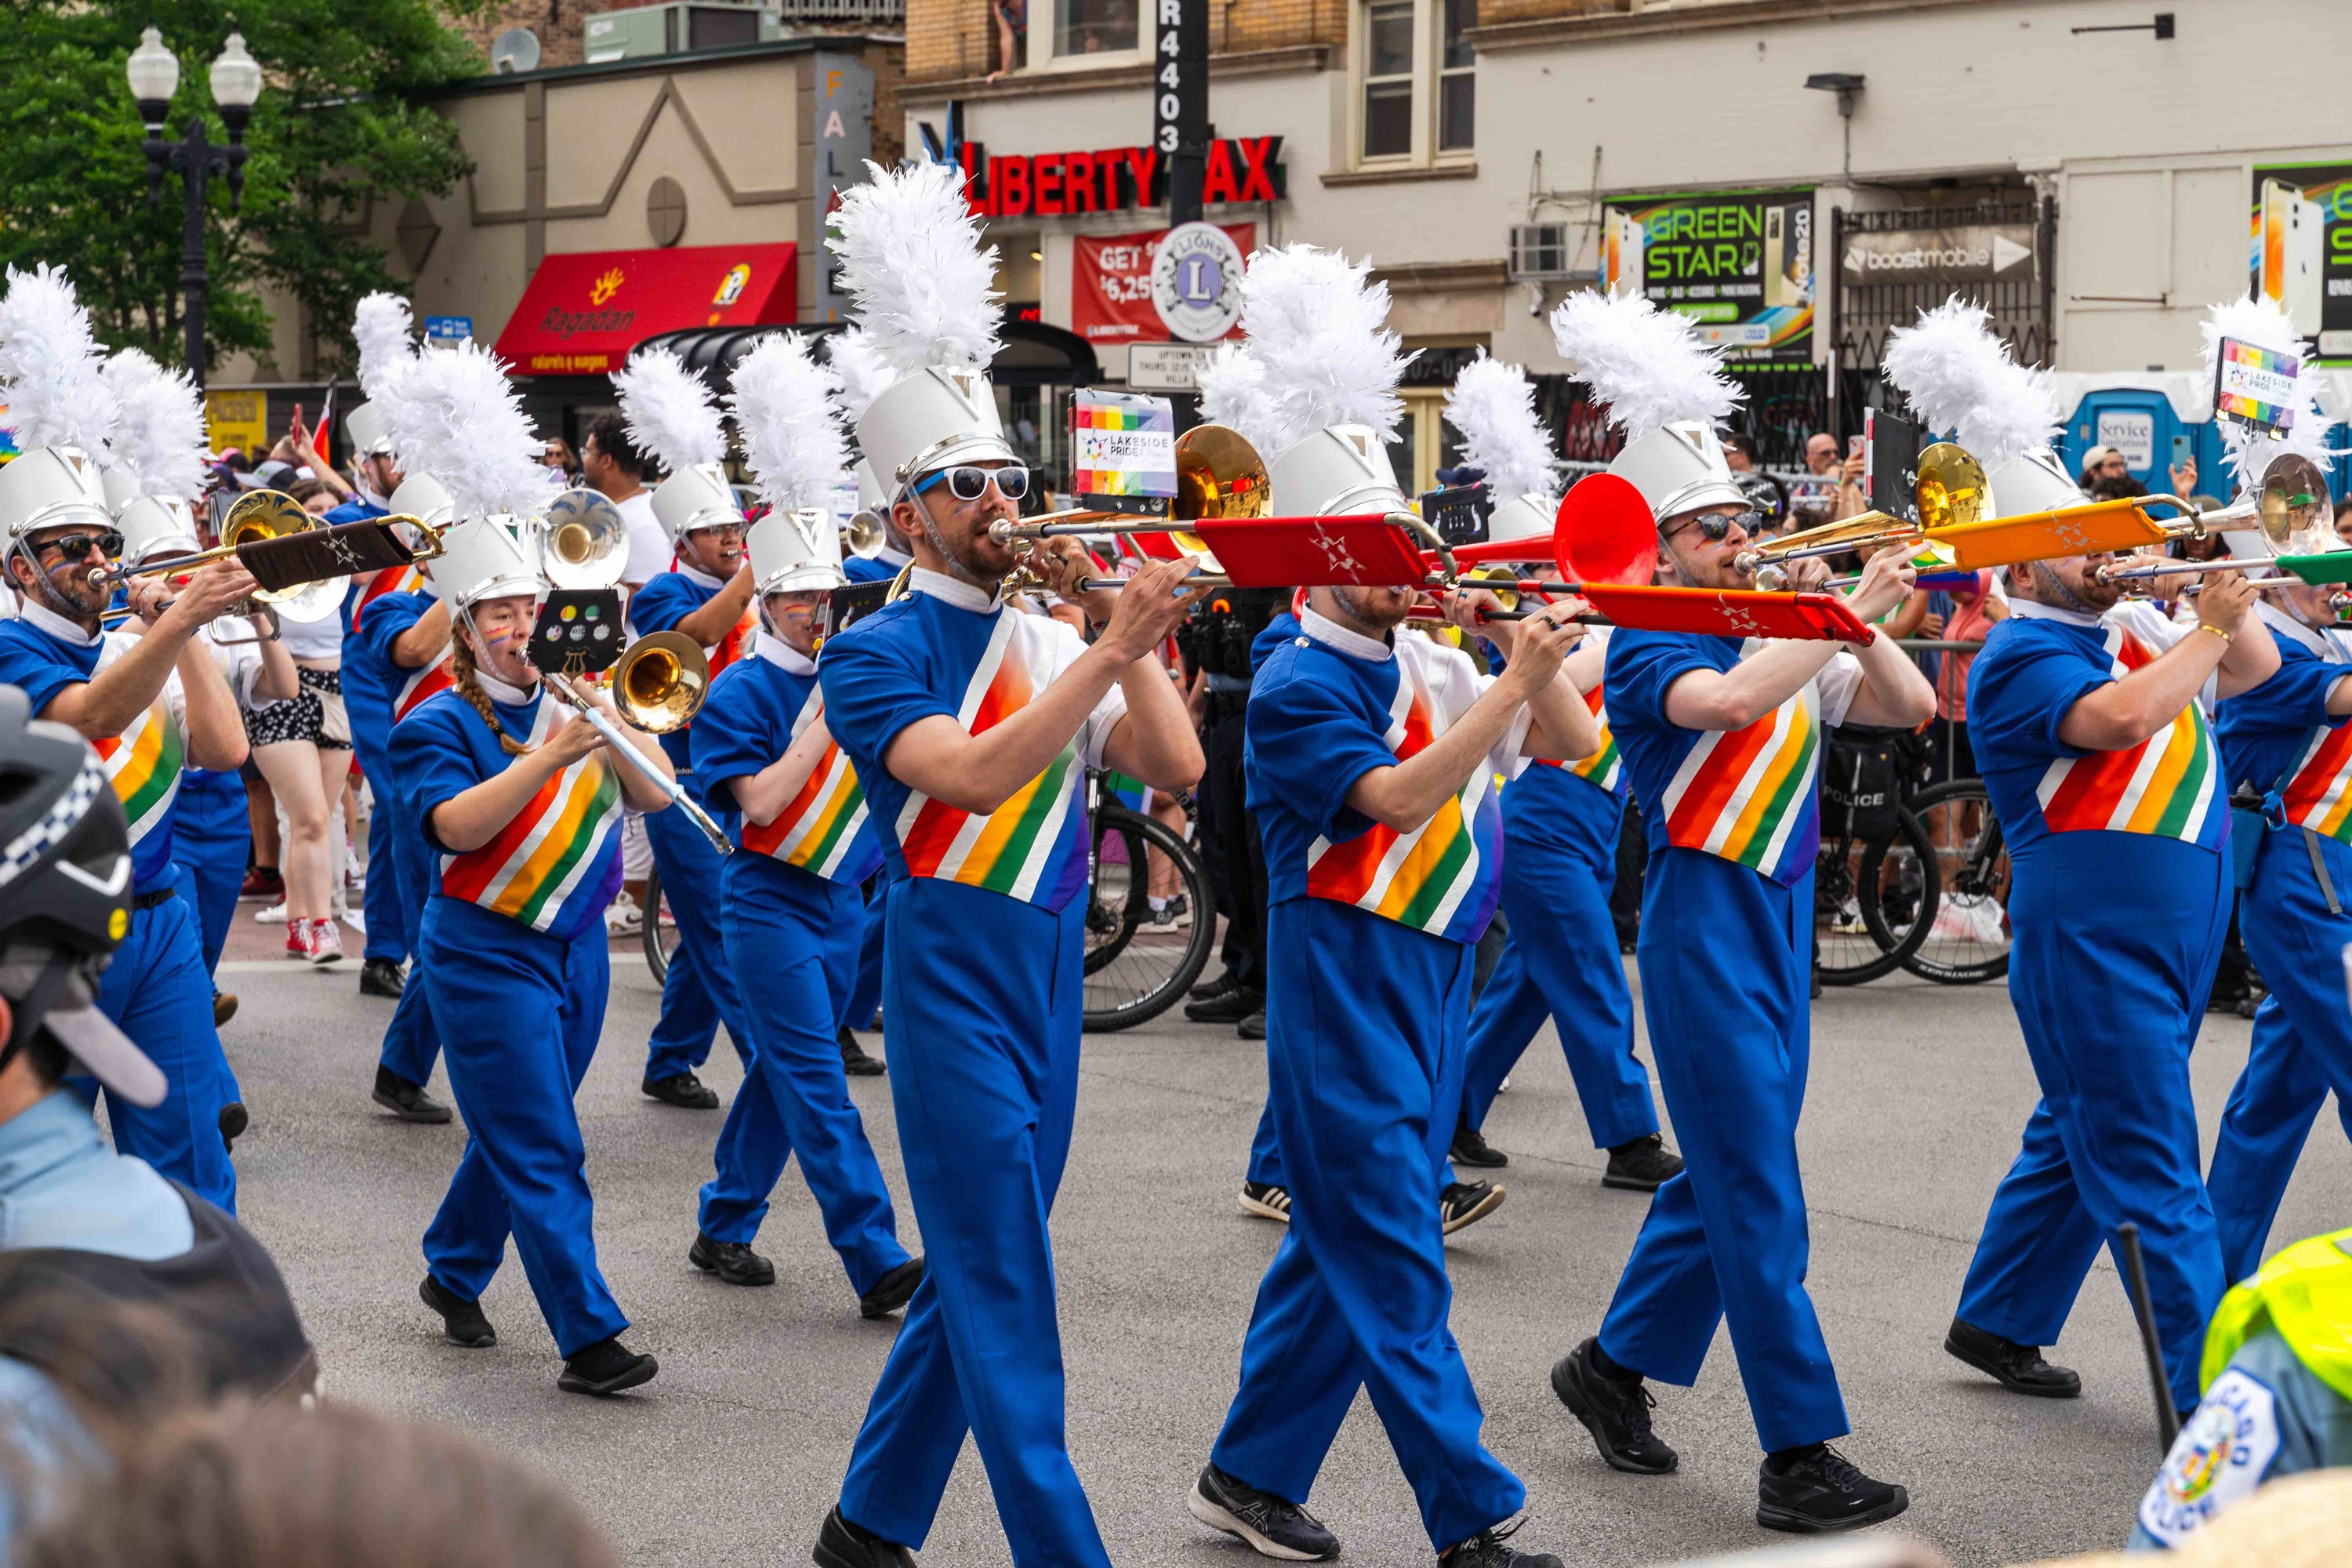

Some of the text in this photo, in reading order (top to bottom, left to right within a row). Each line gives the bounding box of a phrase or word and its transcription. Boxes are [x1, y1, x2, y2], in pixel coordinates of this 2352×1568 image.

[1159, 0, 1181, 152] R4403
[963, 136, 1275, 217] LIBERTY AX
[1648, 204, 1762, 241] GREEN
[1099, 245, 1142, 270] GET
[1178, 235, 1222, 257] LIONS
[1795, 209, 1811, 303] Note20
[1647, 244, 1739, 279] STAR
[1100, 275, 1152, 304] $6,25
[1187, 260, 1213, 301] L
[539, 305, 636, 340] Ragadan
[2249, 379, 2271, 392] PRIDE
[2250, 371, 2293, 390] LAKESIDE
[1110, 434, 1168, 448] LAKESIDE
[2101, 421, 2148, 437] Service
[1110, 446, 1138, 456] PRIDE
[1823, 784, 1885, 808] POLICE
